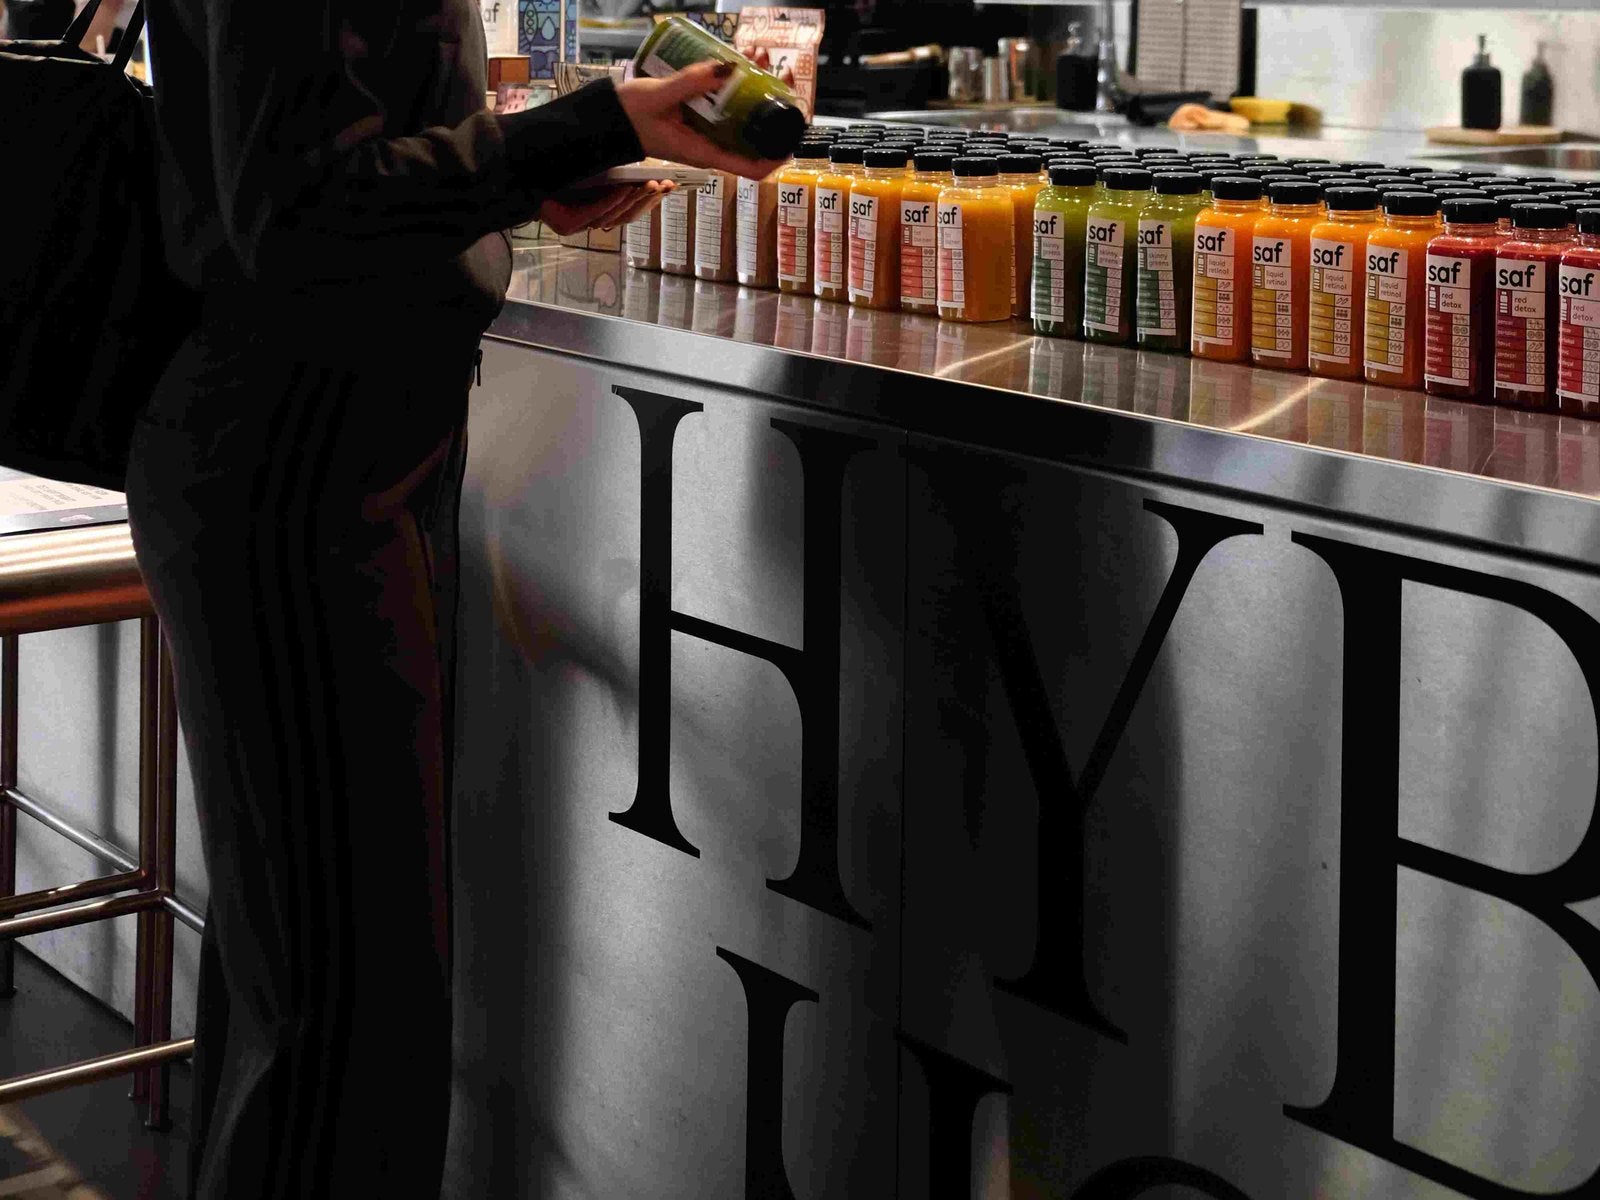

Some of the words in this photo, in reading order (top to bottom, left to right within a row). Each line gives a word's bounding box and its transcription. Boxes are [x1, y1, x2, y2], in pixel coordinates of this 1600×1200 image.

[482, 2, 500, 23] af
[781, 188, 803, 205] saf
[852, 200, 873, 217] saf
[904, 205, 930, 223] saf
[1089, 223, 1117, 242] saf
[1197, 231, 1227, 252] saf
[1254, 242, 1284, 263] saf
[1313, 245, 1345, 266] saf
[1368, 252, 1400, 274] saf
[1428, 262, 1462, 284] saf
[1498, 265, 1537, 288] saf
[1560, 273, 1595, 296] saf
[1441, 291, 1453, 300] red
[1441, 300, 1462, 309] detox
[1514, 296, 1527, 304] red
[1514, 303, 1537, 313] detox
[1572, 312, 1594, 322] detox
[1573, 304, 1584, 312] red
